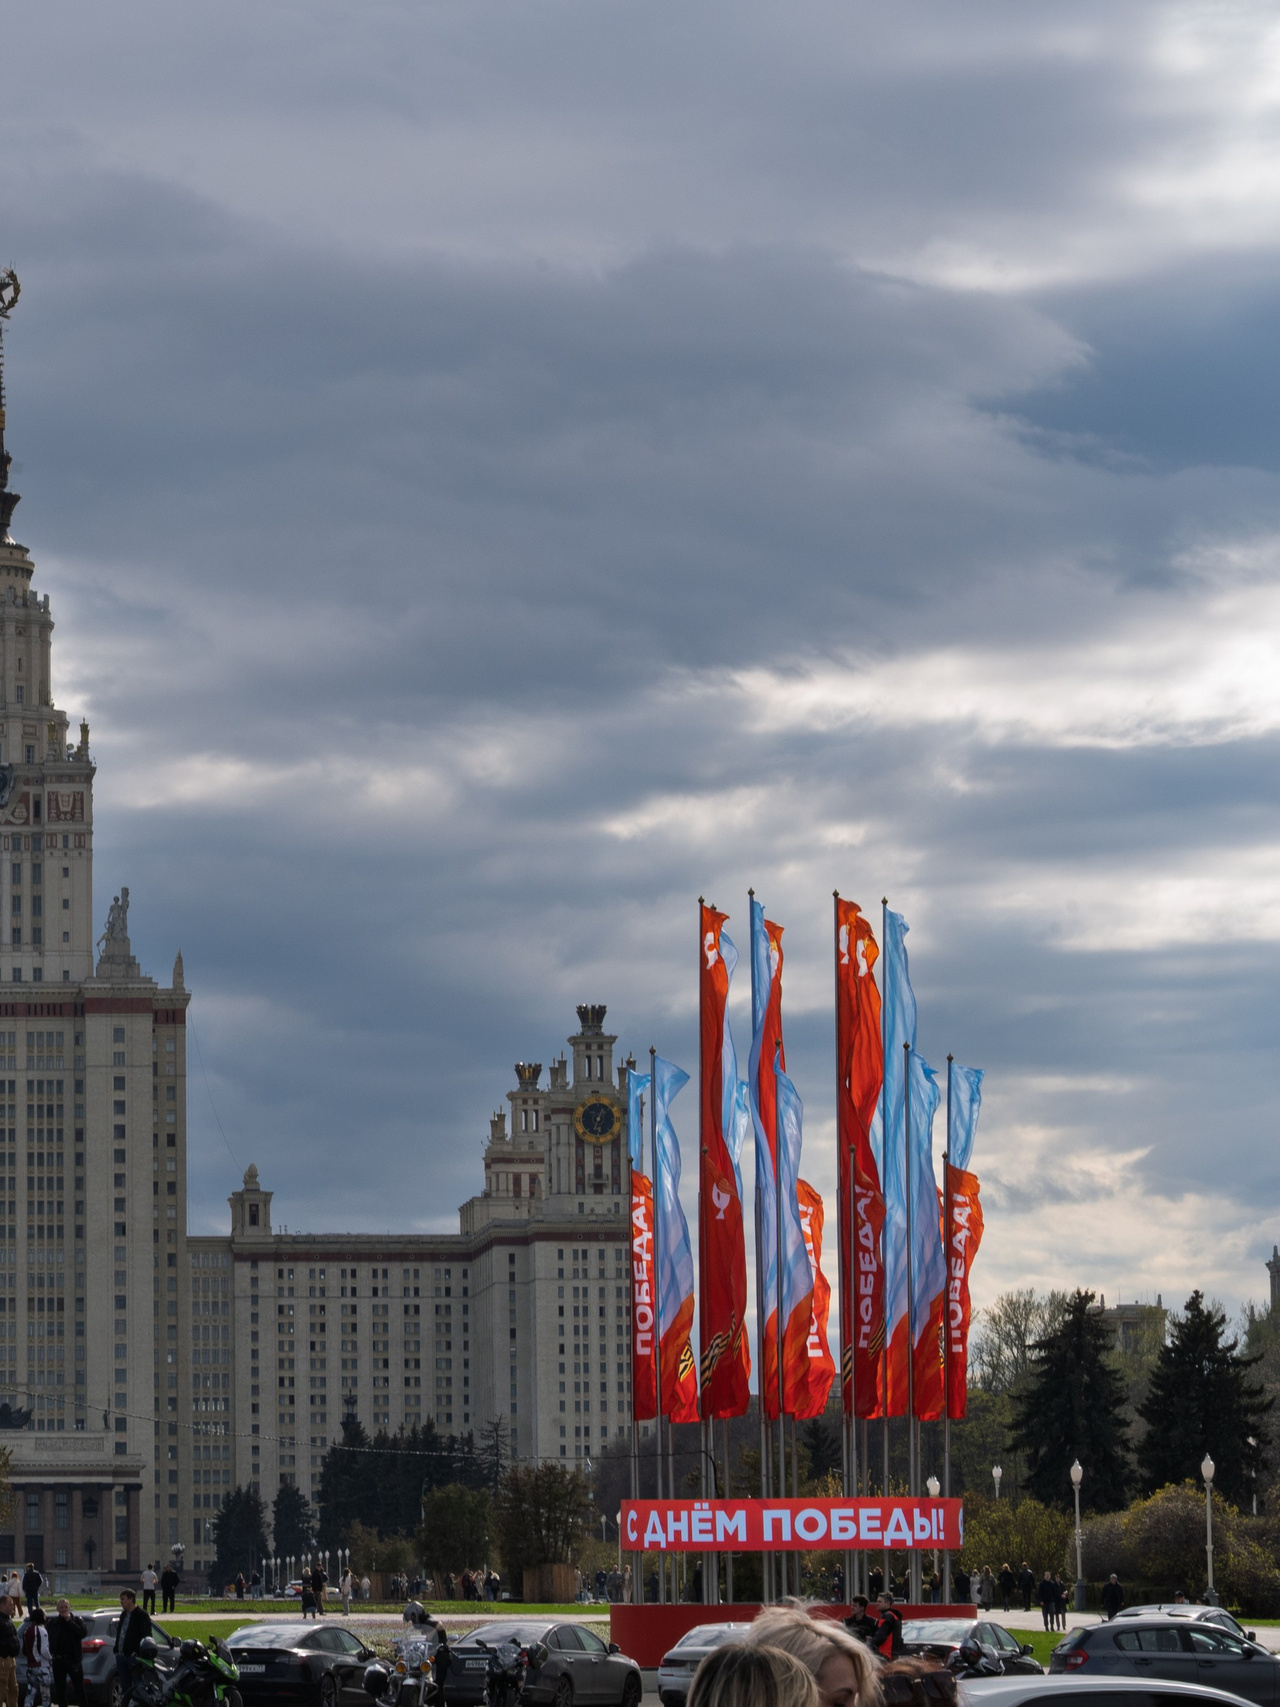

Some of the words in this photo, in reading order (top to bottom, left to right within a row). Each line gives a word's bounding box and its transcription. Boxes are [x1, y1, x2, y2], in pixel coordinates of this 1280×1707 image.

[632, 1195, 654, 1356] ПОБЕДА!
[854, 1184, 878, 1349] ПОБЕДА!
[949, 1192, 973, 1353] ПОБЕДА!
[627, 1509, 638, 1542] С
[643, 1502, 747, 1549] ДНЁМ
[762, 1507, 945, 1547] ПОБЕДЫ!
